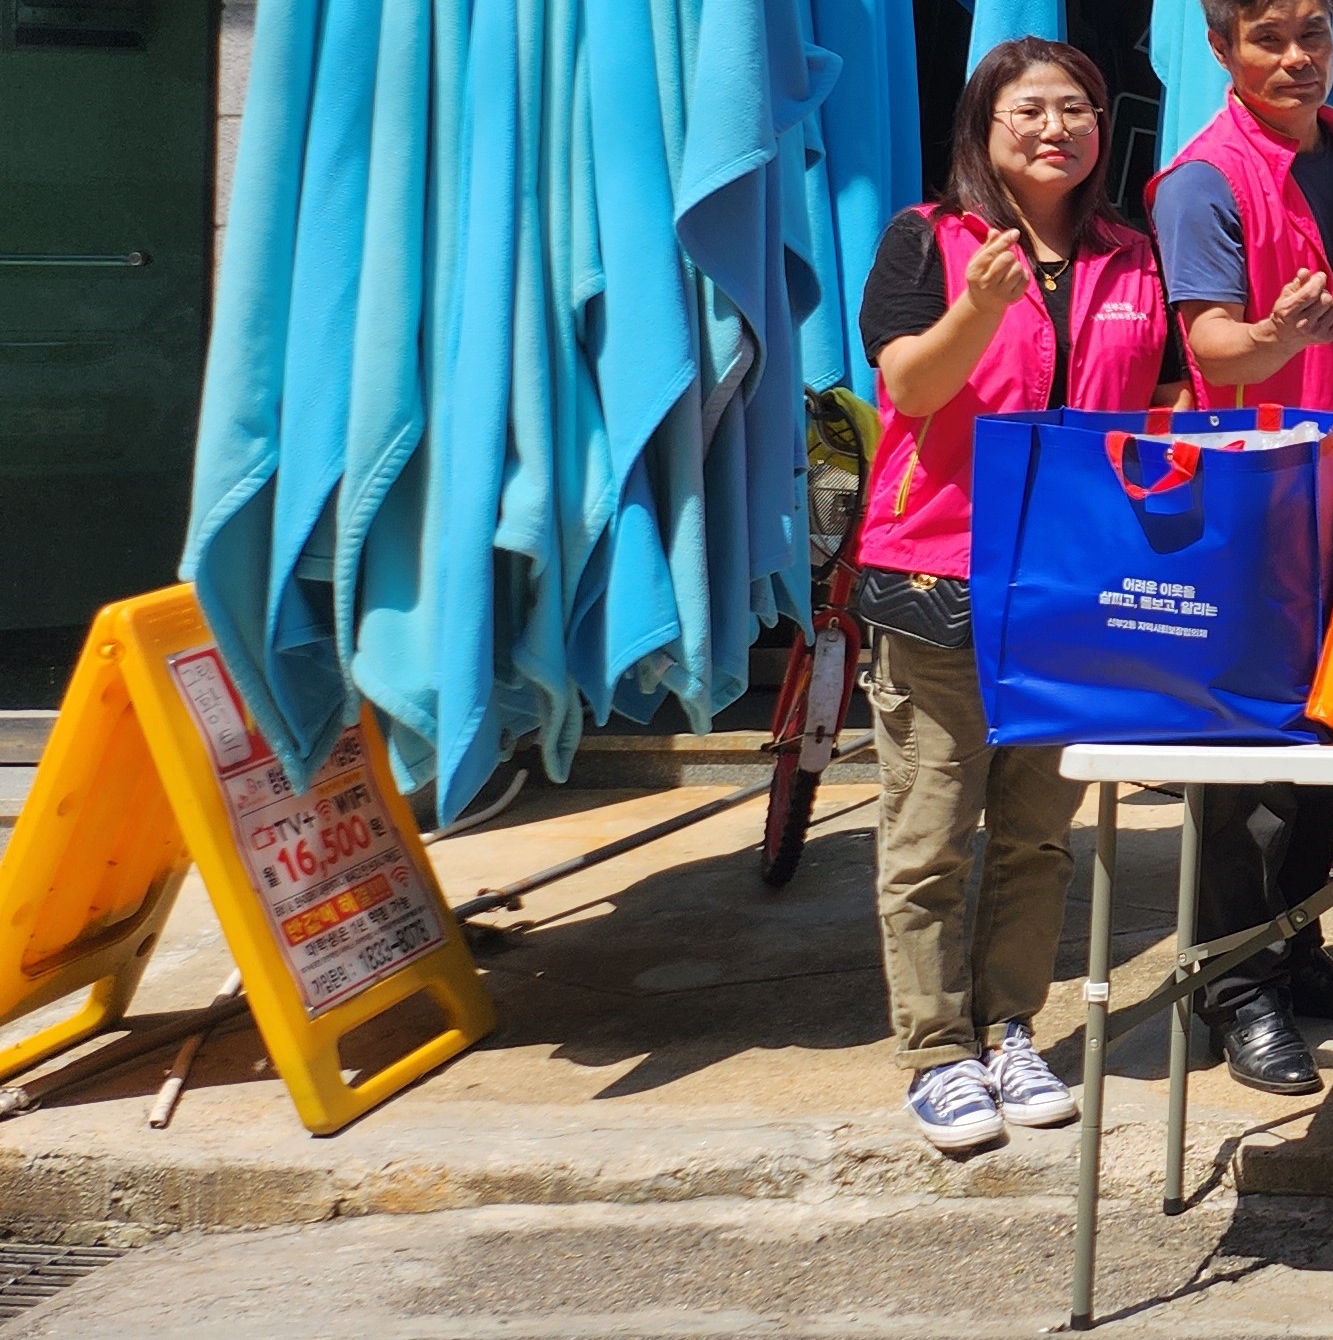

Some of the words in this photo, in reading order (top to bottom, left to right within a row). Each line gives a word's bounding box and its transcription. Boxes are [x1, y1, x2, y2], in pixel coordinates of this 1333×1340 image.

[1122, 578, 1158, 595] 어려운
[1160, 583, 1196, 599] 이웃을
[1099, 591, 1138, 609] 살피고,
[1140, 596, 1179, 614] 돌보고,
[1180, 601, 1218, 617] 알리는
[276, 814, 373, 883] 16,500
